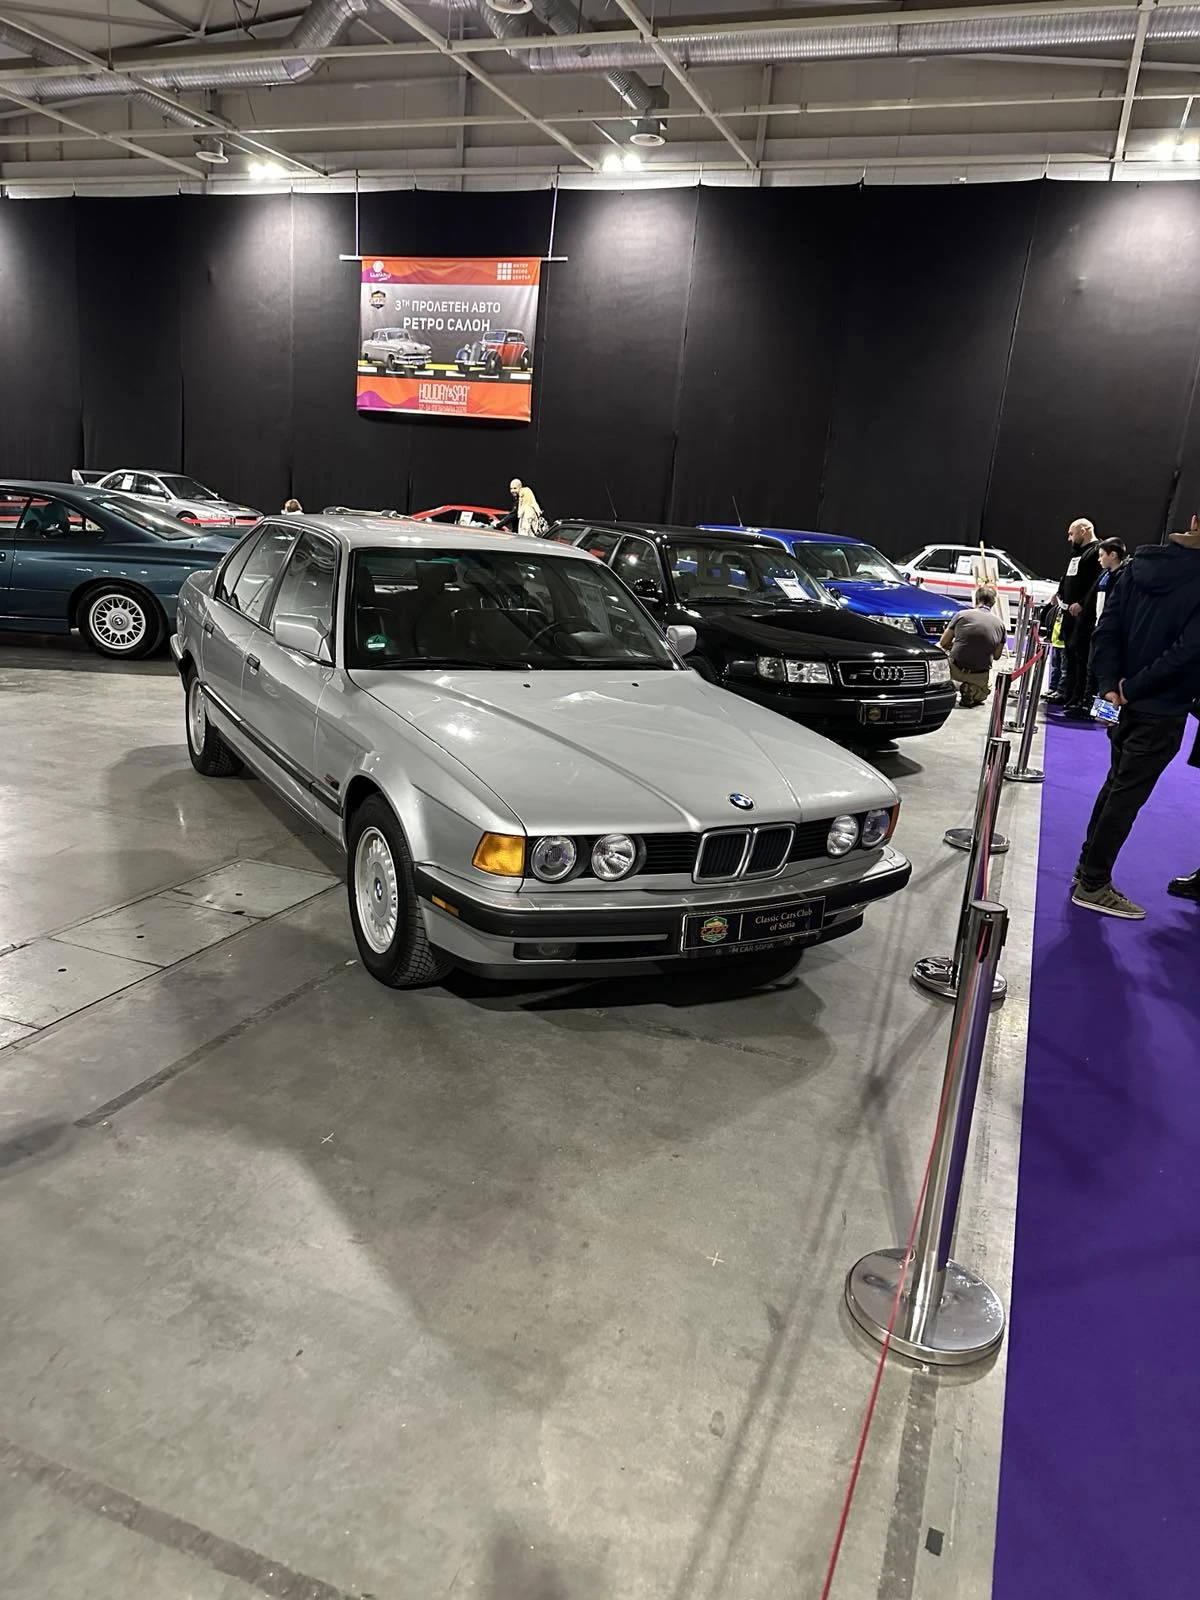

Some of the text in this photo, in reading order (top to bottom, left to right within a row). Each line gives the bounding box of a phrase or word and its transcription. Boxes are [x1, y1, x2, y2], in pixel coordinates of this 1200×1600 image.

[411, 300, 470, 313] ПРОЛЕТЕН
[471, 301, 501, 314] АВТО
[403, 316, 491, 332] РЕТРО САЛОН
[755, 907, 813, 925] Classic Cars Club
[769, 920, 796, 931] of Sofia
